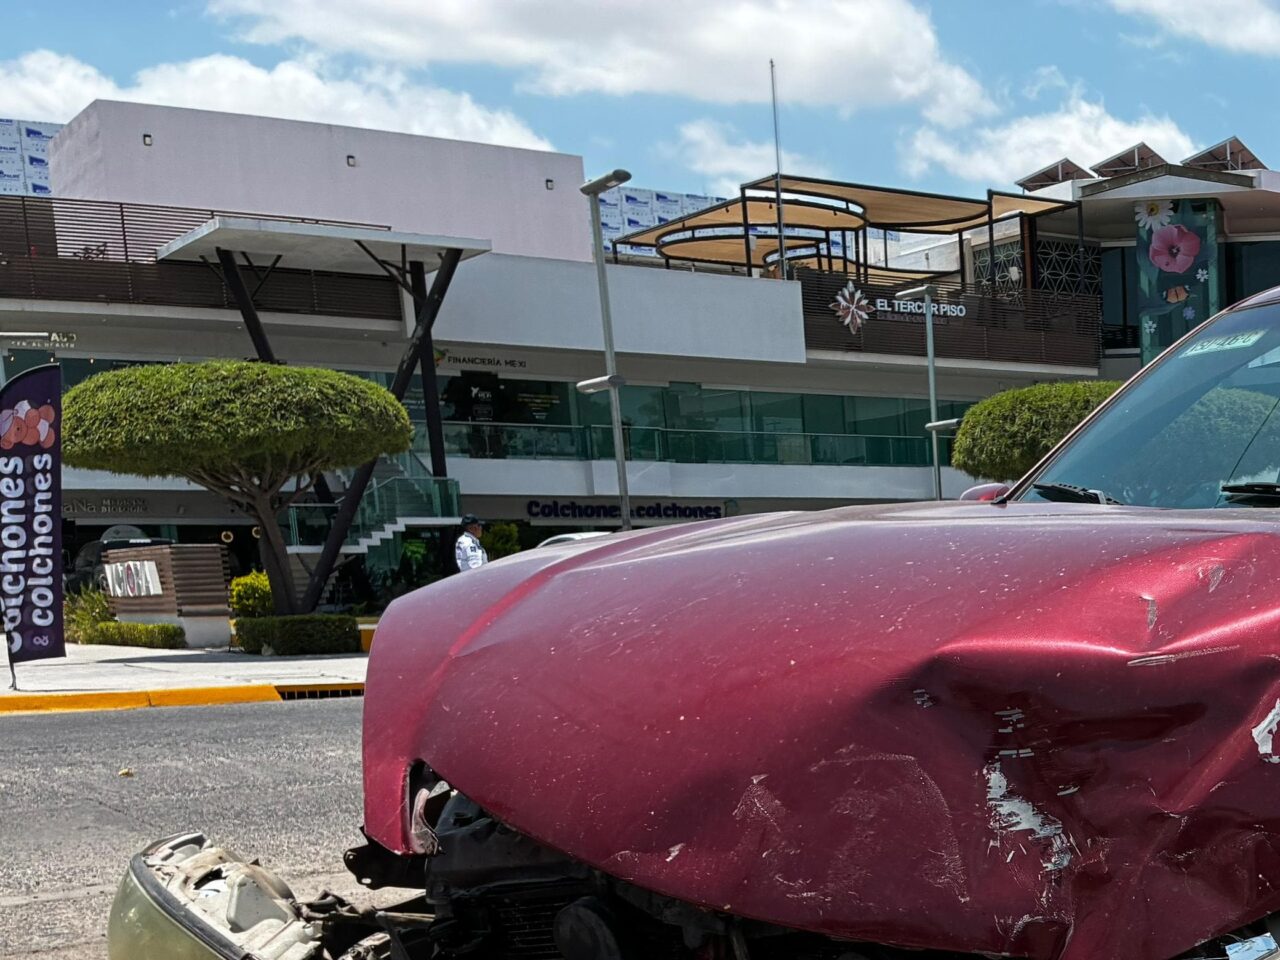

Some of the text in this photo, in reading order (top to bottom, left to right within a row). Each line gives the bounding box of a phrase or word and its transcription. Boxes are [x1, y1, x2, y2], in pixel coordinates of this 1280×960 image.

[876, 298, 892, 312] EL
[940, 303, 967, 317] PISO
[526, 500, 622, 519] Colchone
[636, 502, 722, 519] colchones
[27, 453, 54, 627] colchones
